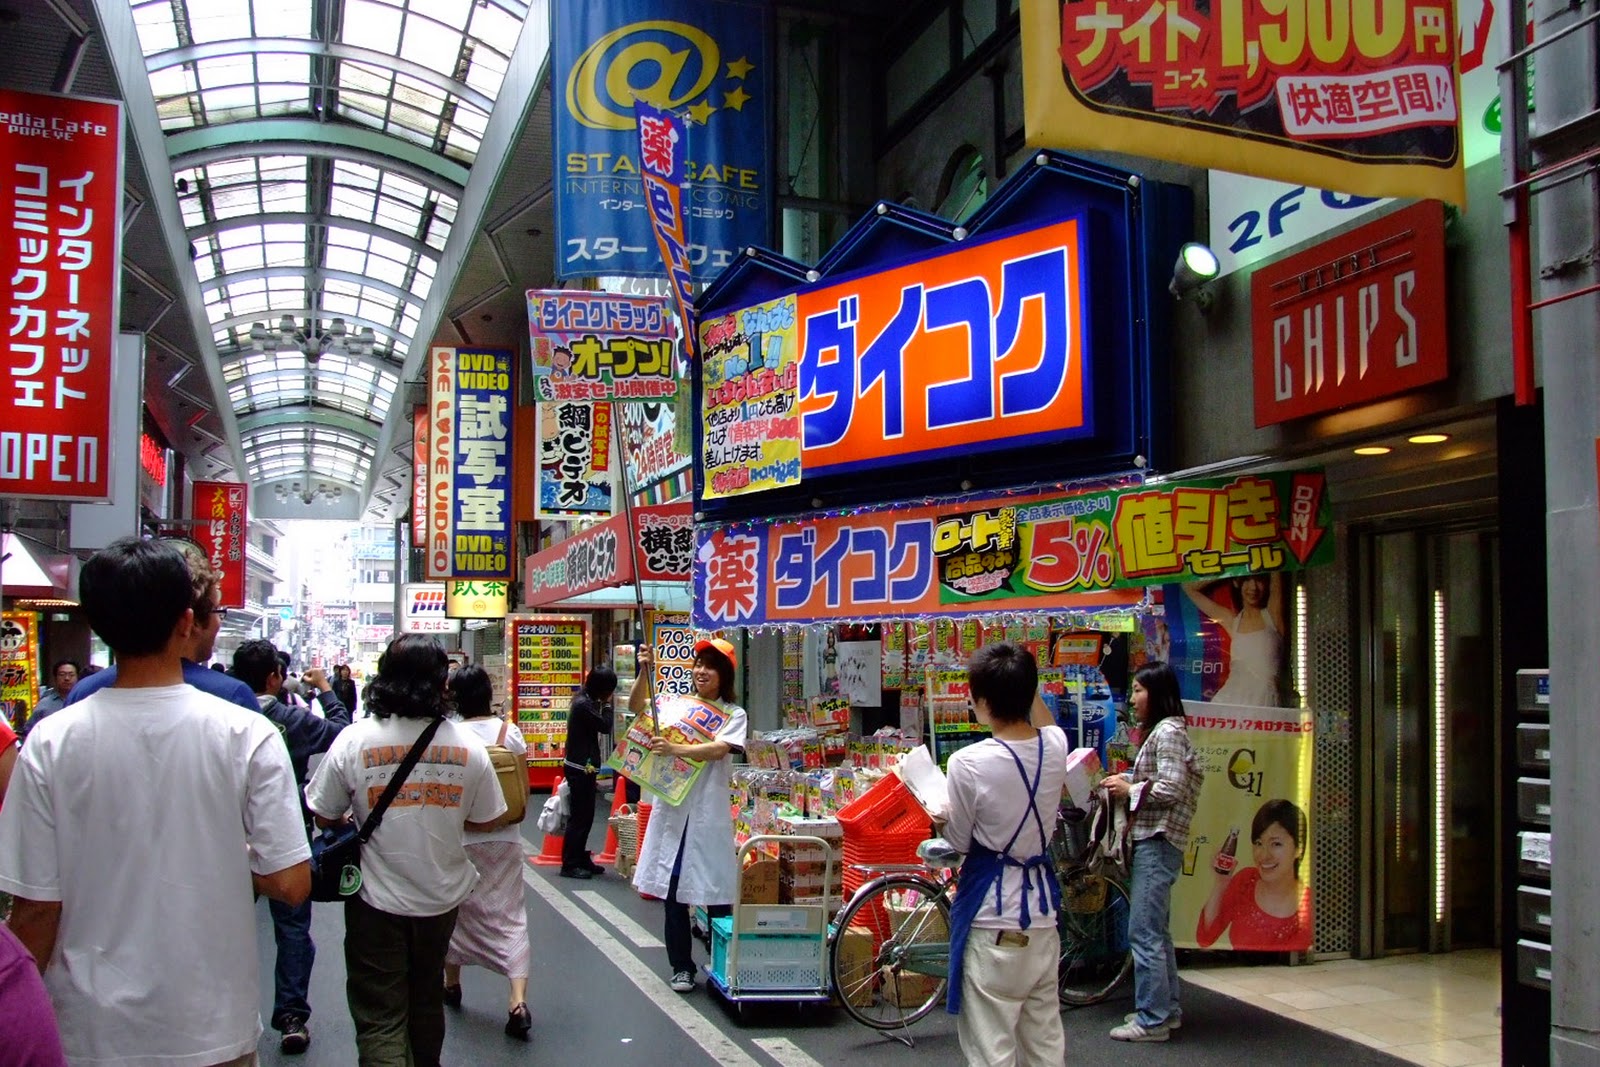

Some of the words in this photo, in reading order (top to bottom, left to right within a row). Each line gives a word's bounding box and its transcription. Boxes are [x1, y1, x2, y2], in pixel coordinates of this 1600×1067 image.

[1075, 1, 1201, 67] ナイト
[1163, 68, 1208, 90] コース
[8, 124, 74, 142] POPEYE
[51, 117, 108, 137] Cafe
[641, 116, 678, 177] 薬
[566, 152, 642, 175] STA
[692, 188, 760, 211] COMIC
[10, 163, 49, 408] コミックカフェ
[55, 171, 94, 410] インターネット
[542, 299, 662, 332] ダイコクドラッグ
[798, 246, 1070, 450] ダイコク
[1273, 270, 1418, 402] CHIPS
[459, 353, 495, 371] DVD
[570, 335, 674, 377] オープン!
[458, 372, 510, 391] VIDEO
[554, 379, 678, 400] 激安セール開催中
[0, 432, 98, 483] OPEN
[457, 394, 508, 531] 試写室
[558, 402, 591, 504] 綱ビデオ
[634, 430, 686, 482] 24時間営
[705, 442, 764, 470] 差し上げます。
[1016, 497, 1111, 522] 全品表示価格より
[1290, 485, 1314, 542] DOWN
[1112, 480, 1278, 575] 値引き
[455, 535, 493, 553] DVD
[1028, 518, 1111, 587] 5%
[455, 554, 507, 572] VIDEO
[566, 527, 617, 591] 横綱ビデオ
[704, 532, 760, 622] 薬
[774, 518, 934, 610] ダイコク
[946, 551, 1013, 580] 商品のみ
[1184, 545, 1284, 575] セール
[519, 636, 532, 647] 30
[550, 636, 567, 647] 580
[660, 630, 694, 645] 70分
[519, 649, 532, 659] 60
[519, 661, 532, 671] 90
[1191, 659, 1224, 675] Ban
[551, 711, 567, 721] 200
